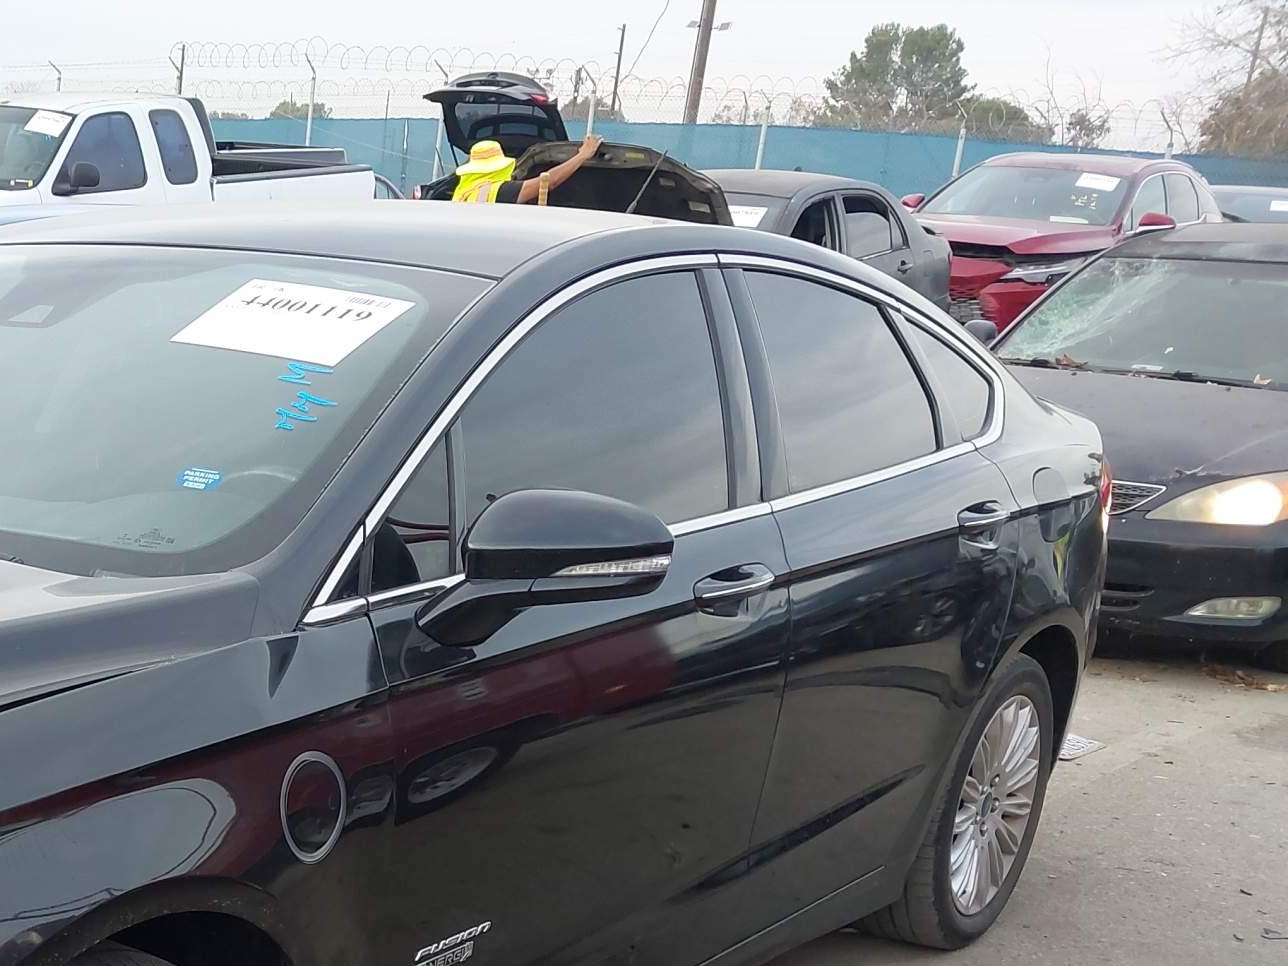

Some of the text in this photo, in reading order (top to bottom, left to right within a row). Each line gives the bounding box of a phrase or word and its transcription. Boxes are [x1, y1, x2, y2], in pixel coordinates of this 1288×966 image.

[241, 295, 373, 321] 44001119
[183, 470, 220, 480] PARKING
[183, 475, 215, 484] PERMIT
